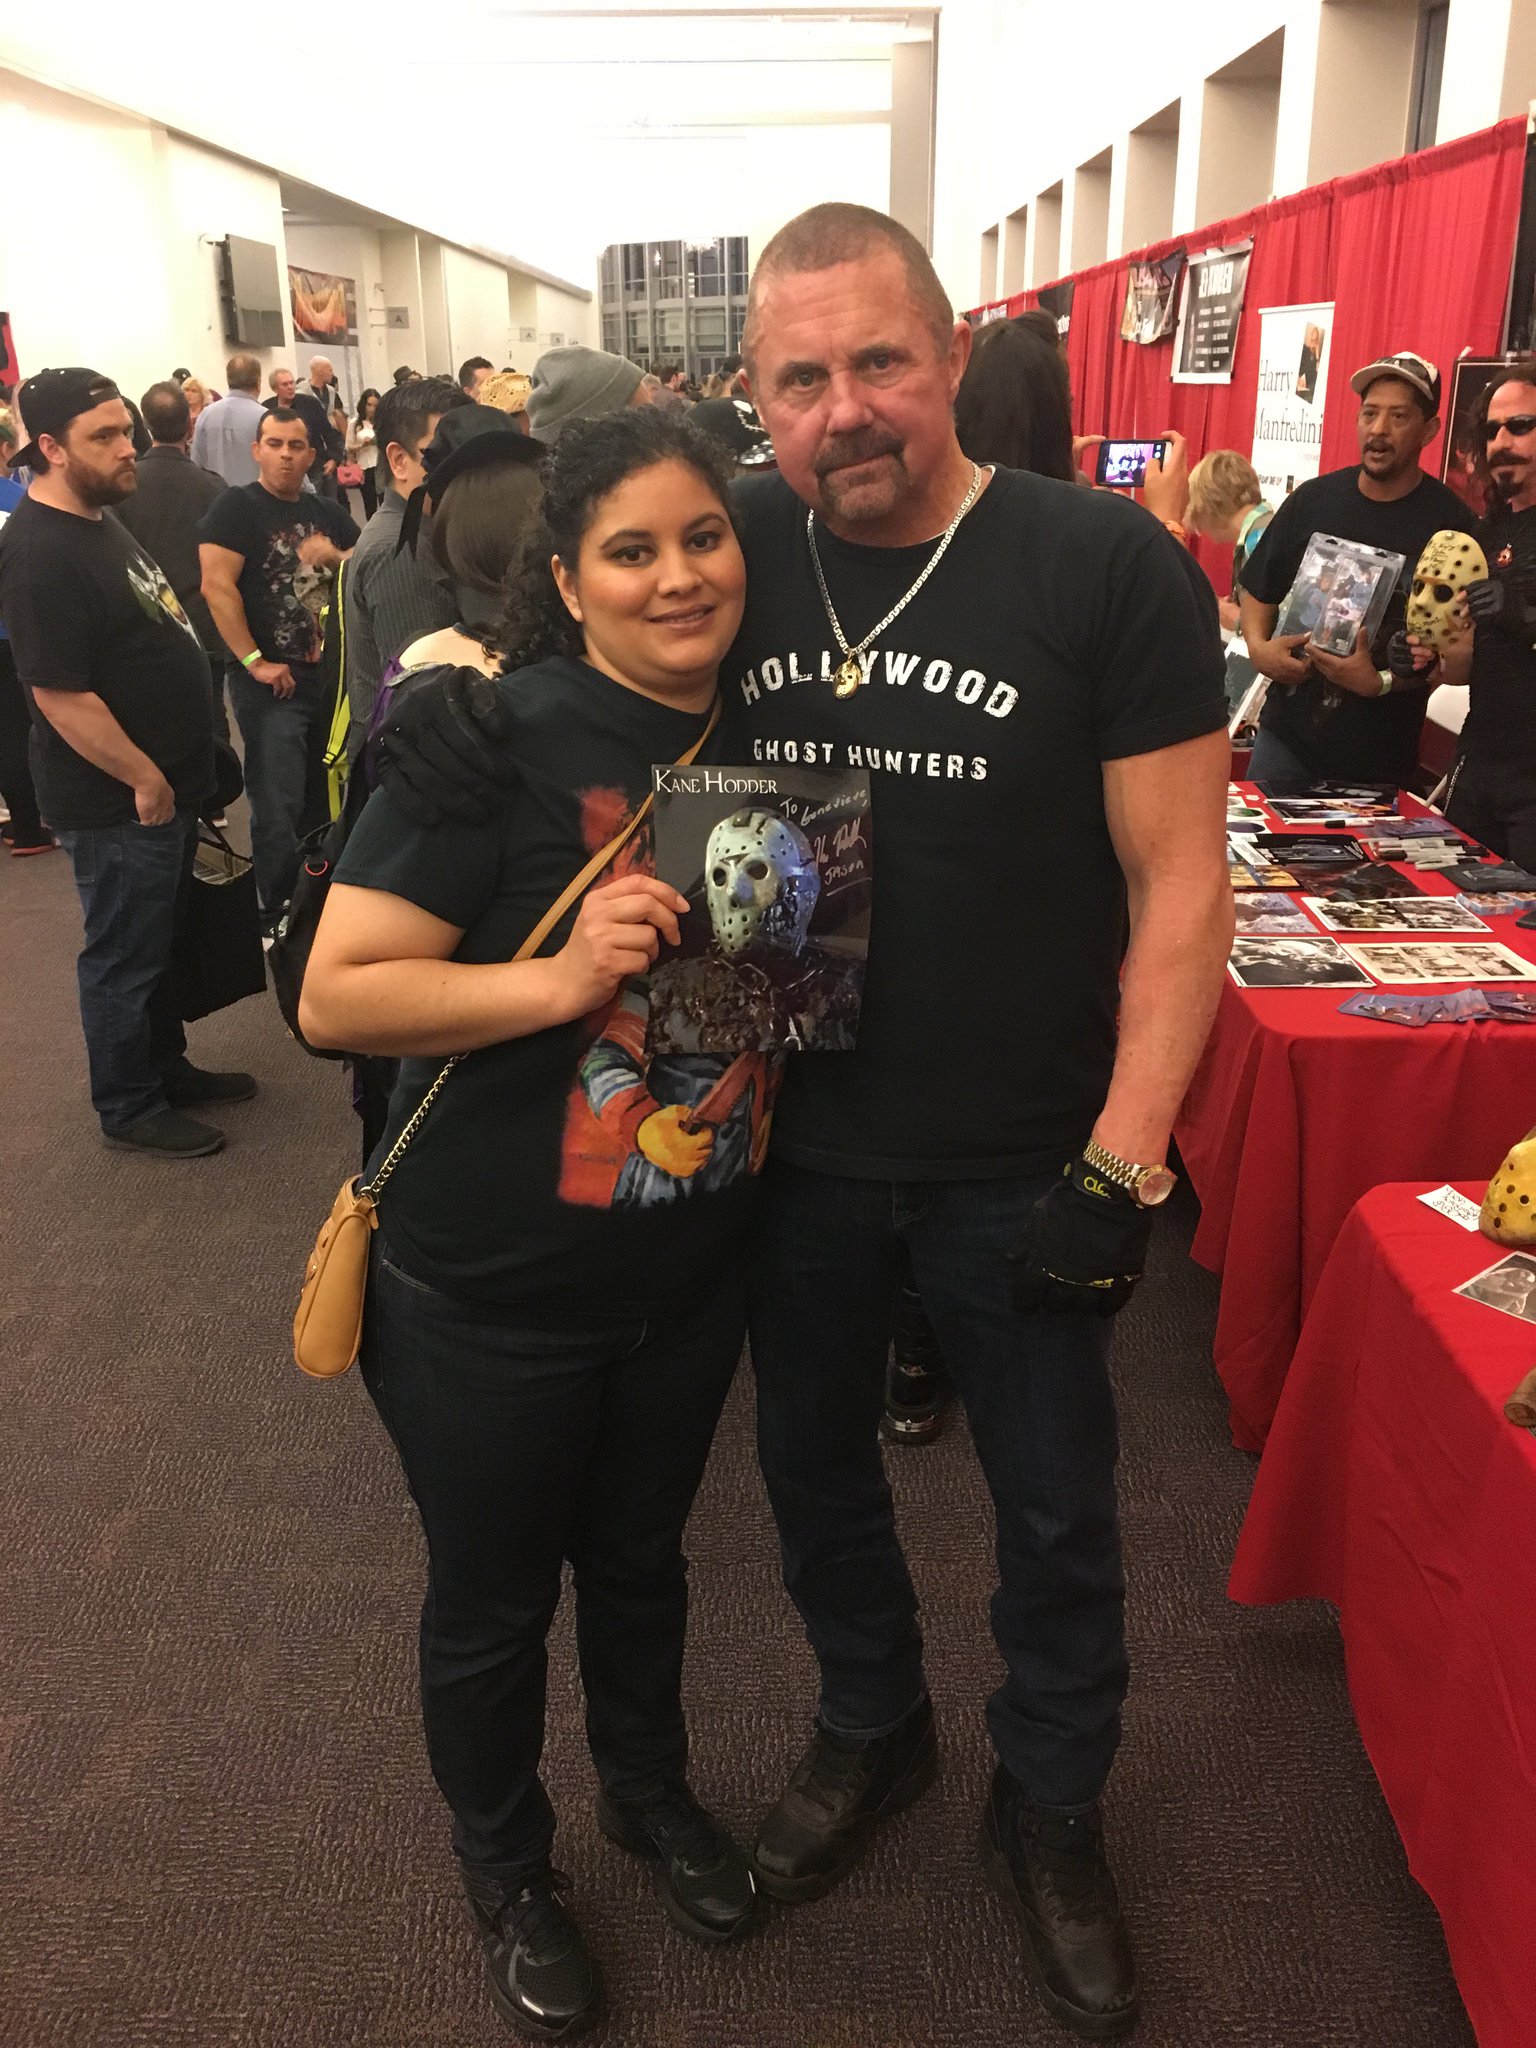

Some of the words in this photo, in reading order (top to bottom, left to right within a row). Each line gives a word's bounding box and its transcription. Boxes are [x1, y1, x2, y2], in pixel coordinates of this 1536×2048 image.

[1258, 359, 1294, 400] Harry
[739, 650, 1019, 718] HOLLYWOOD
[753, 738, 834, 764] GHOST
[847, 744, 988, 781] HUNTERS
